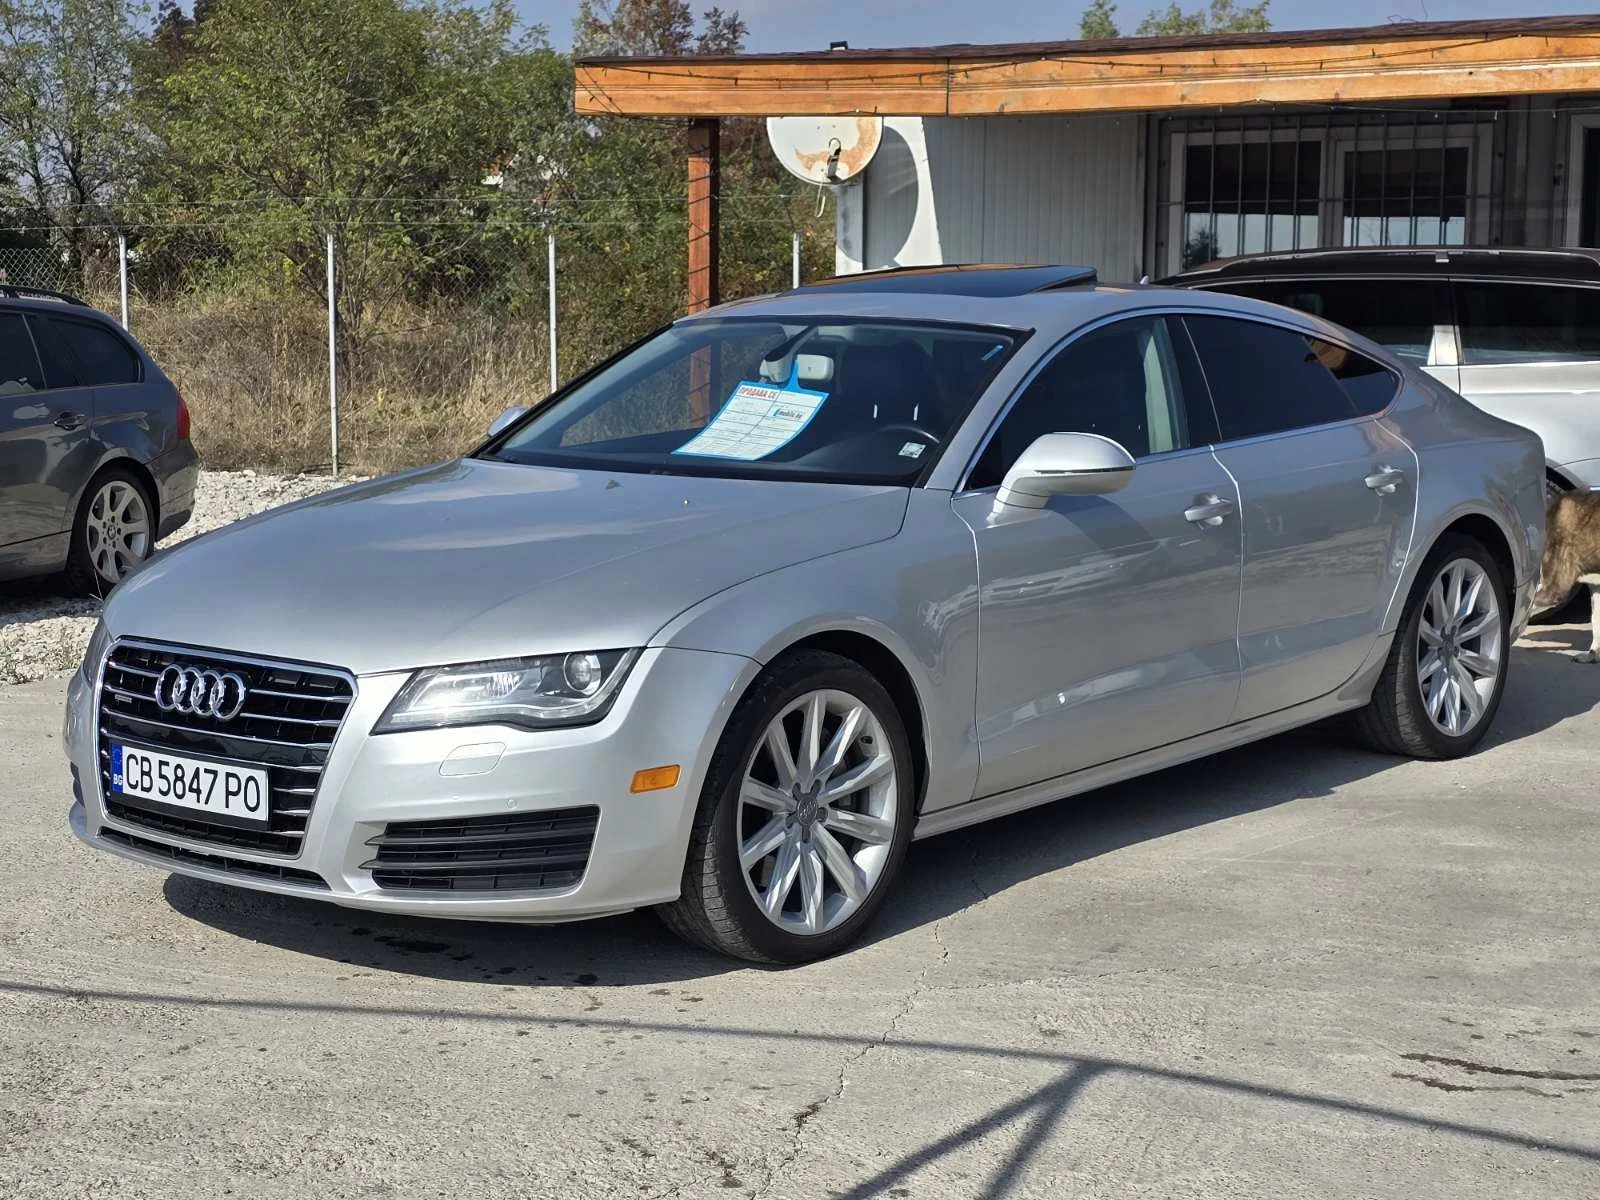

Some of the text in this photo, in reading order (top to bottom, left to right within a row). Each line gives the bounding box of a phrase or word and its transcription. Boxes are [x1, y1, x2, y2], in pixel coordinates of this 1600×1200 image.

[113, 773, 123, 786] BG
[126, 753, 261, 813] CB 5847 PO
